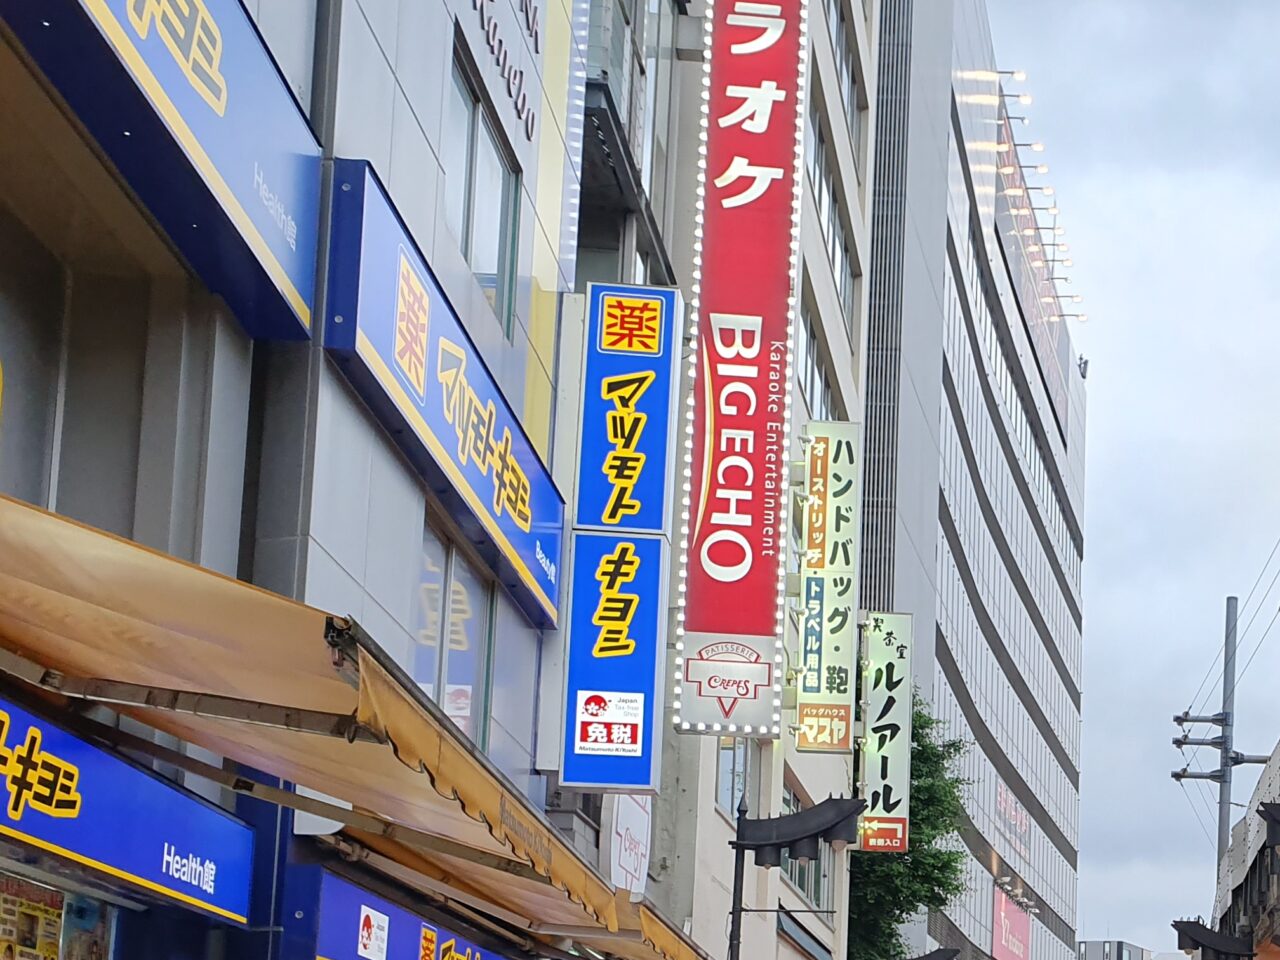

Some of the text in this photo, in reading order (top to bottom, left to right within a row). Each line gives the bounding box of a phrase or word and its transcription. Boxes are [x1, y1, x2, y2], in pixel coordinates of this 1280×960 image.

[253, 163, 298, 252] Health館
[604, 300, 657, 350] 薬
[700, 312, 763, 583] BIG ECHO
[761, 340, 784, 557] Karaoke Entertainment
[704, 643, 755, 660] PATISSERIE
[616, 697, 638, 705] Japan
[707, 675, 750, 697] CREPES
[578, 745, 614, 753] Matsumoto
[587, 722, 633, 745] 免税
[803, 717, 847, 746] マスヤ
[870, 660, 905, 815] ルノアール
[162, 842, 217, 895] Health館
